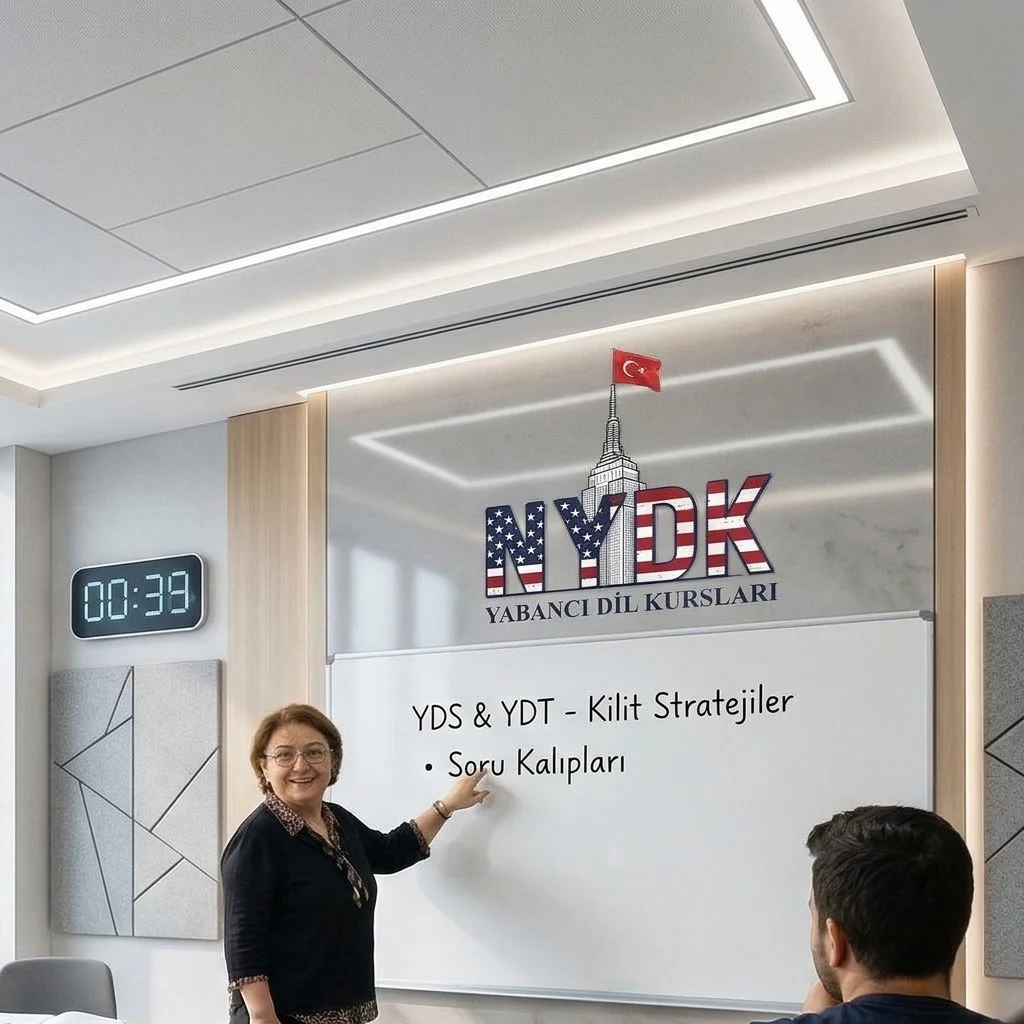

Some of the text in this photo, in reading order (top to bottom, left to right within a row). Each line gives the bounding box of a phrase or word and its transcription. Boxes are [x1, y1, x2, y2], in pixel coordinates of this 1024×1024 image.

[485, 473, 775, 598] NYDK
[84, 570, 189, 622] 00:39
[485, 582, 778, 624] YABANCI DİL KURSLARI
[412, 703, 464, 732] YDS
[472, 701, 493, 729] &
[500, 697, 556, 728] YDT
[588, 693, 643, 723] Kilit
[653, 683, 795, 726] Stratejiler
[448, 744, 626, 786] Soru Kalıpları
